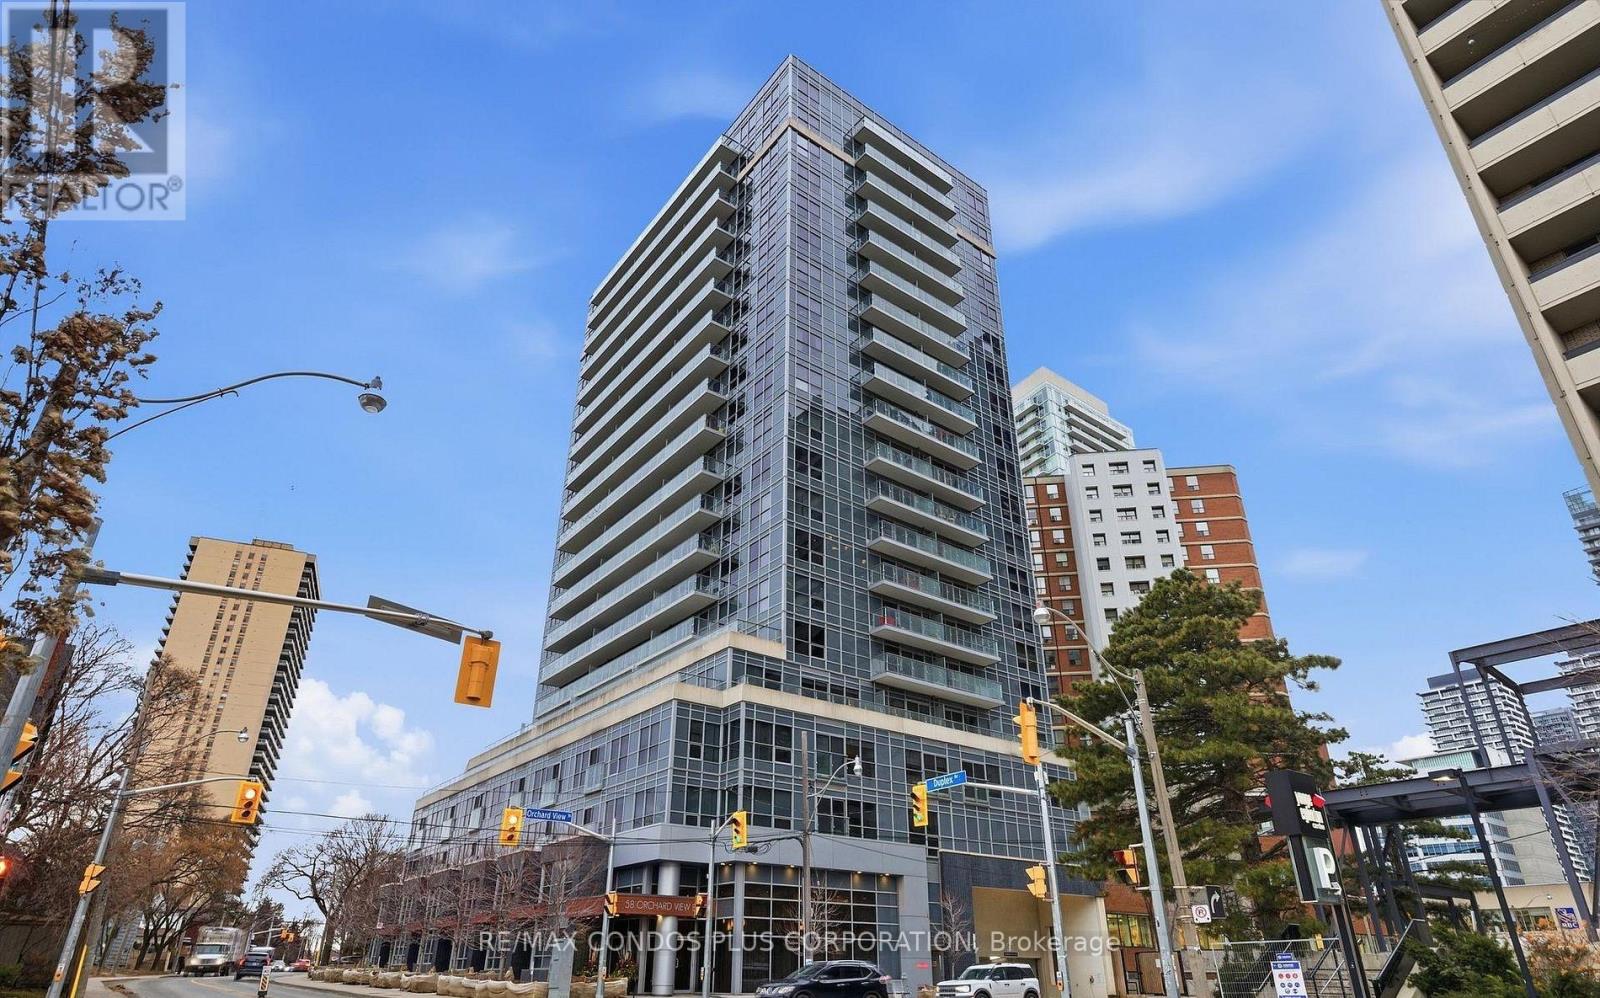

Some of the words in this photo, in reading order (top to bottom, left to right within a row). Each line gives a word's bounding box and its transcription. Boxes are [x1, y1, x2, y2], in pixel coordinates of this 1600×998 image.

[933, 775, 954, 788] Duplex
[527, 810, 551, 819] Orchard
[552, 812, 567, 820] View
[636, 901, 673, 911] ORCHARD
[674, 903, 691, 912] VIEW
